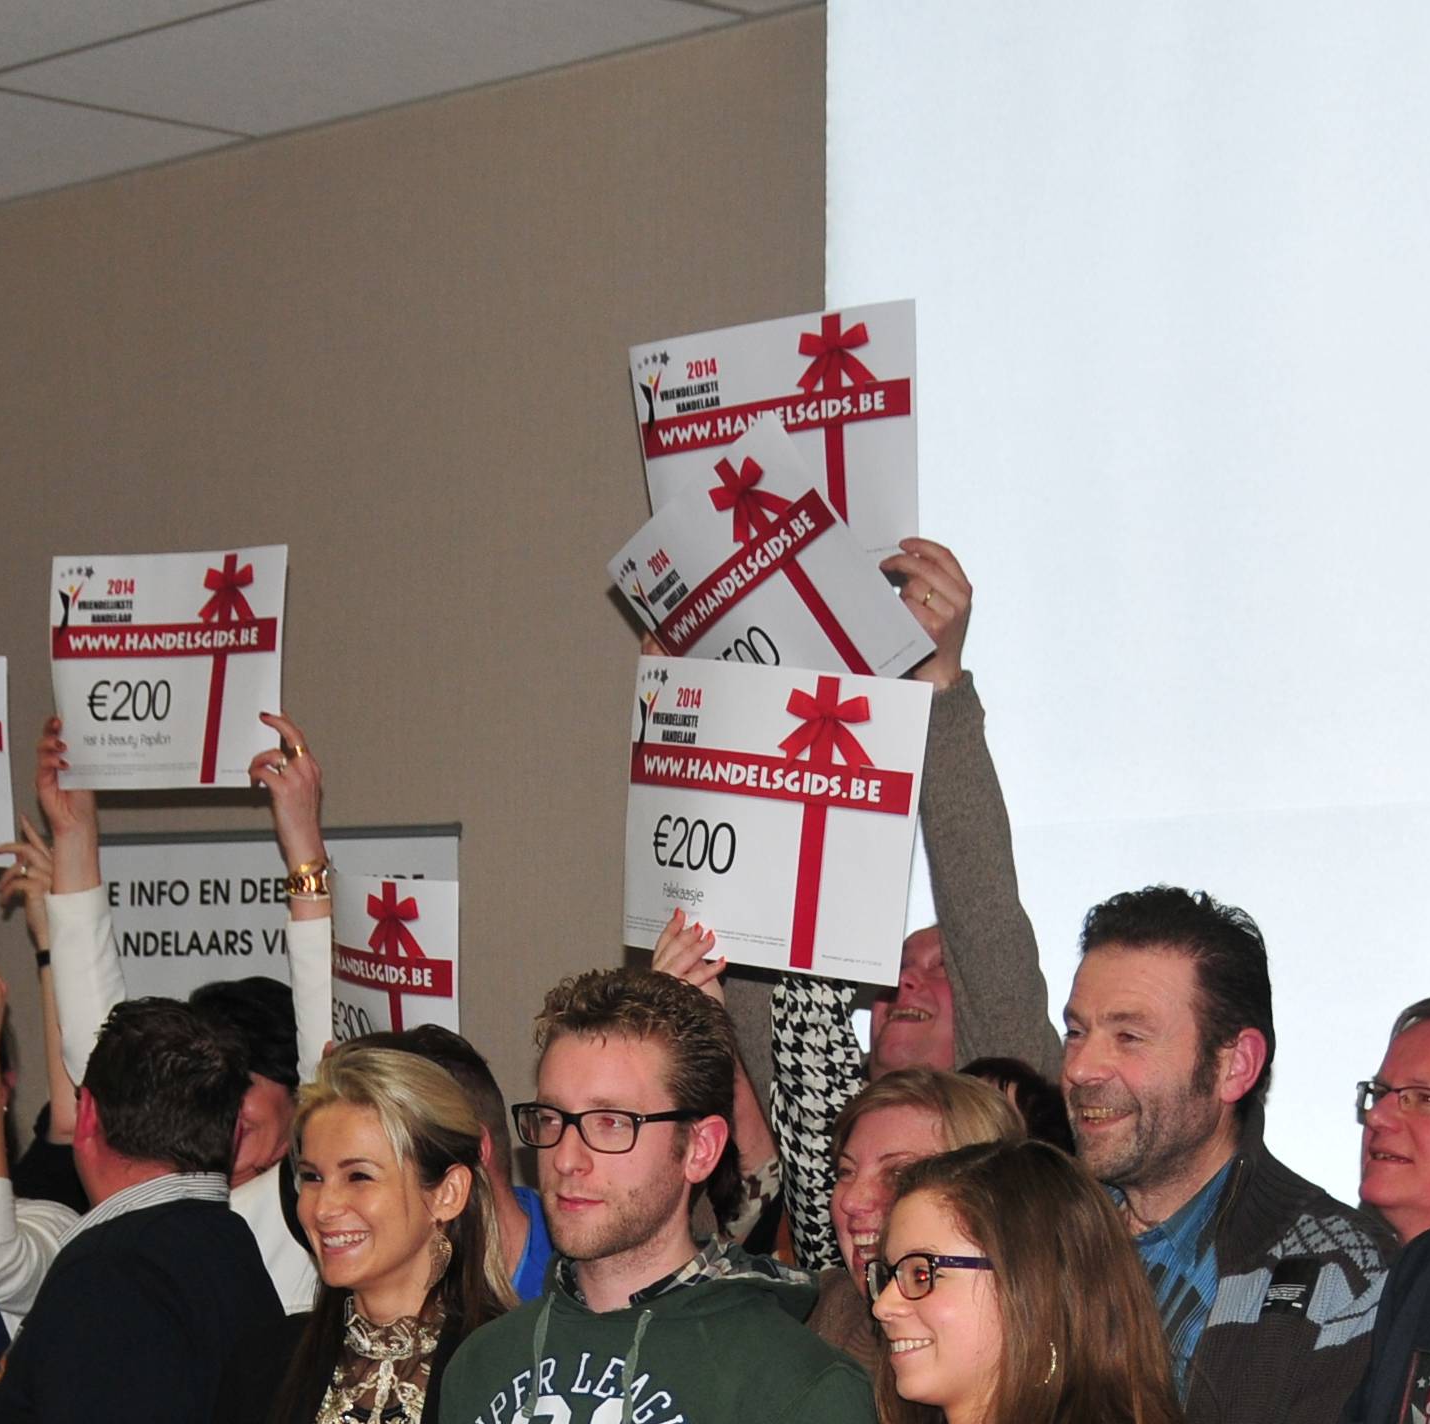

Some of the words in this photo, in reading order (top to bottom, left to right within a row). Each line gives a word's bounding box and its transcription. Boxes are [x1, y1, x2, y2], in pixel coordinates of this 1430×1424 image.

[686, 358, 718, 380] 2014
[647, 548, 671, 577] 2014
[107, 579, 135, 595] 2014
[668, 510, 816, 645] WWW.HANDELSGIDS.BE
[68, 627, 259, 651] WWW.HANDELSGIDS.BE
[87, 680, 171, 722] €200
[676, 687, 703, 709] 2014
[652, 711, 699, 728] VRIENDELIJKSTE
[661, 729, 696, 745] HANDELAAR
[643, 754, 882, 803] WWW.HANDELSGIDS.BE
[652, 814, 736, 874] €200
[130, 879, 190, 907] INFO
[199, 879, 230, 905] EN
[240, 878, 289, 904] DEE
[116, 929, 253, 957] NDELAARS
[262, 929, 287, 955] VI
